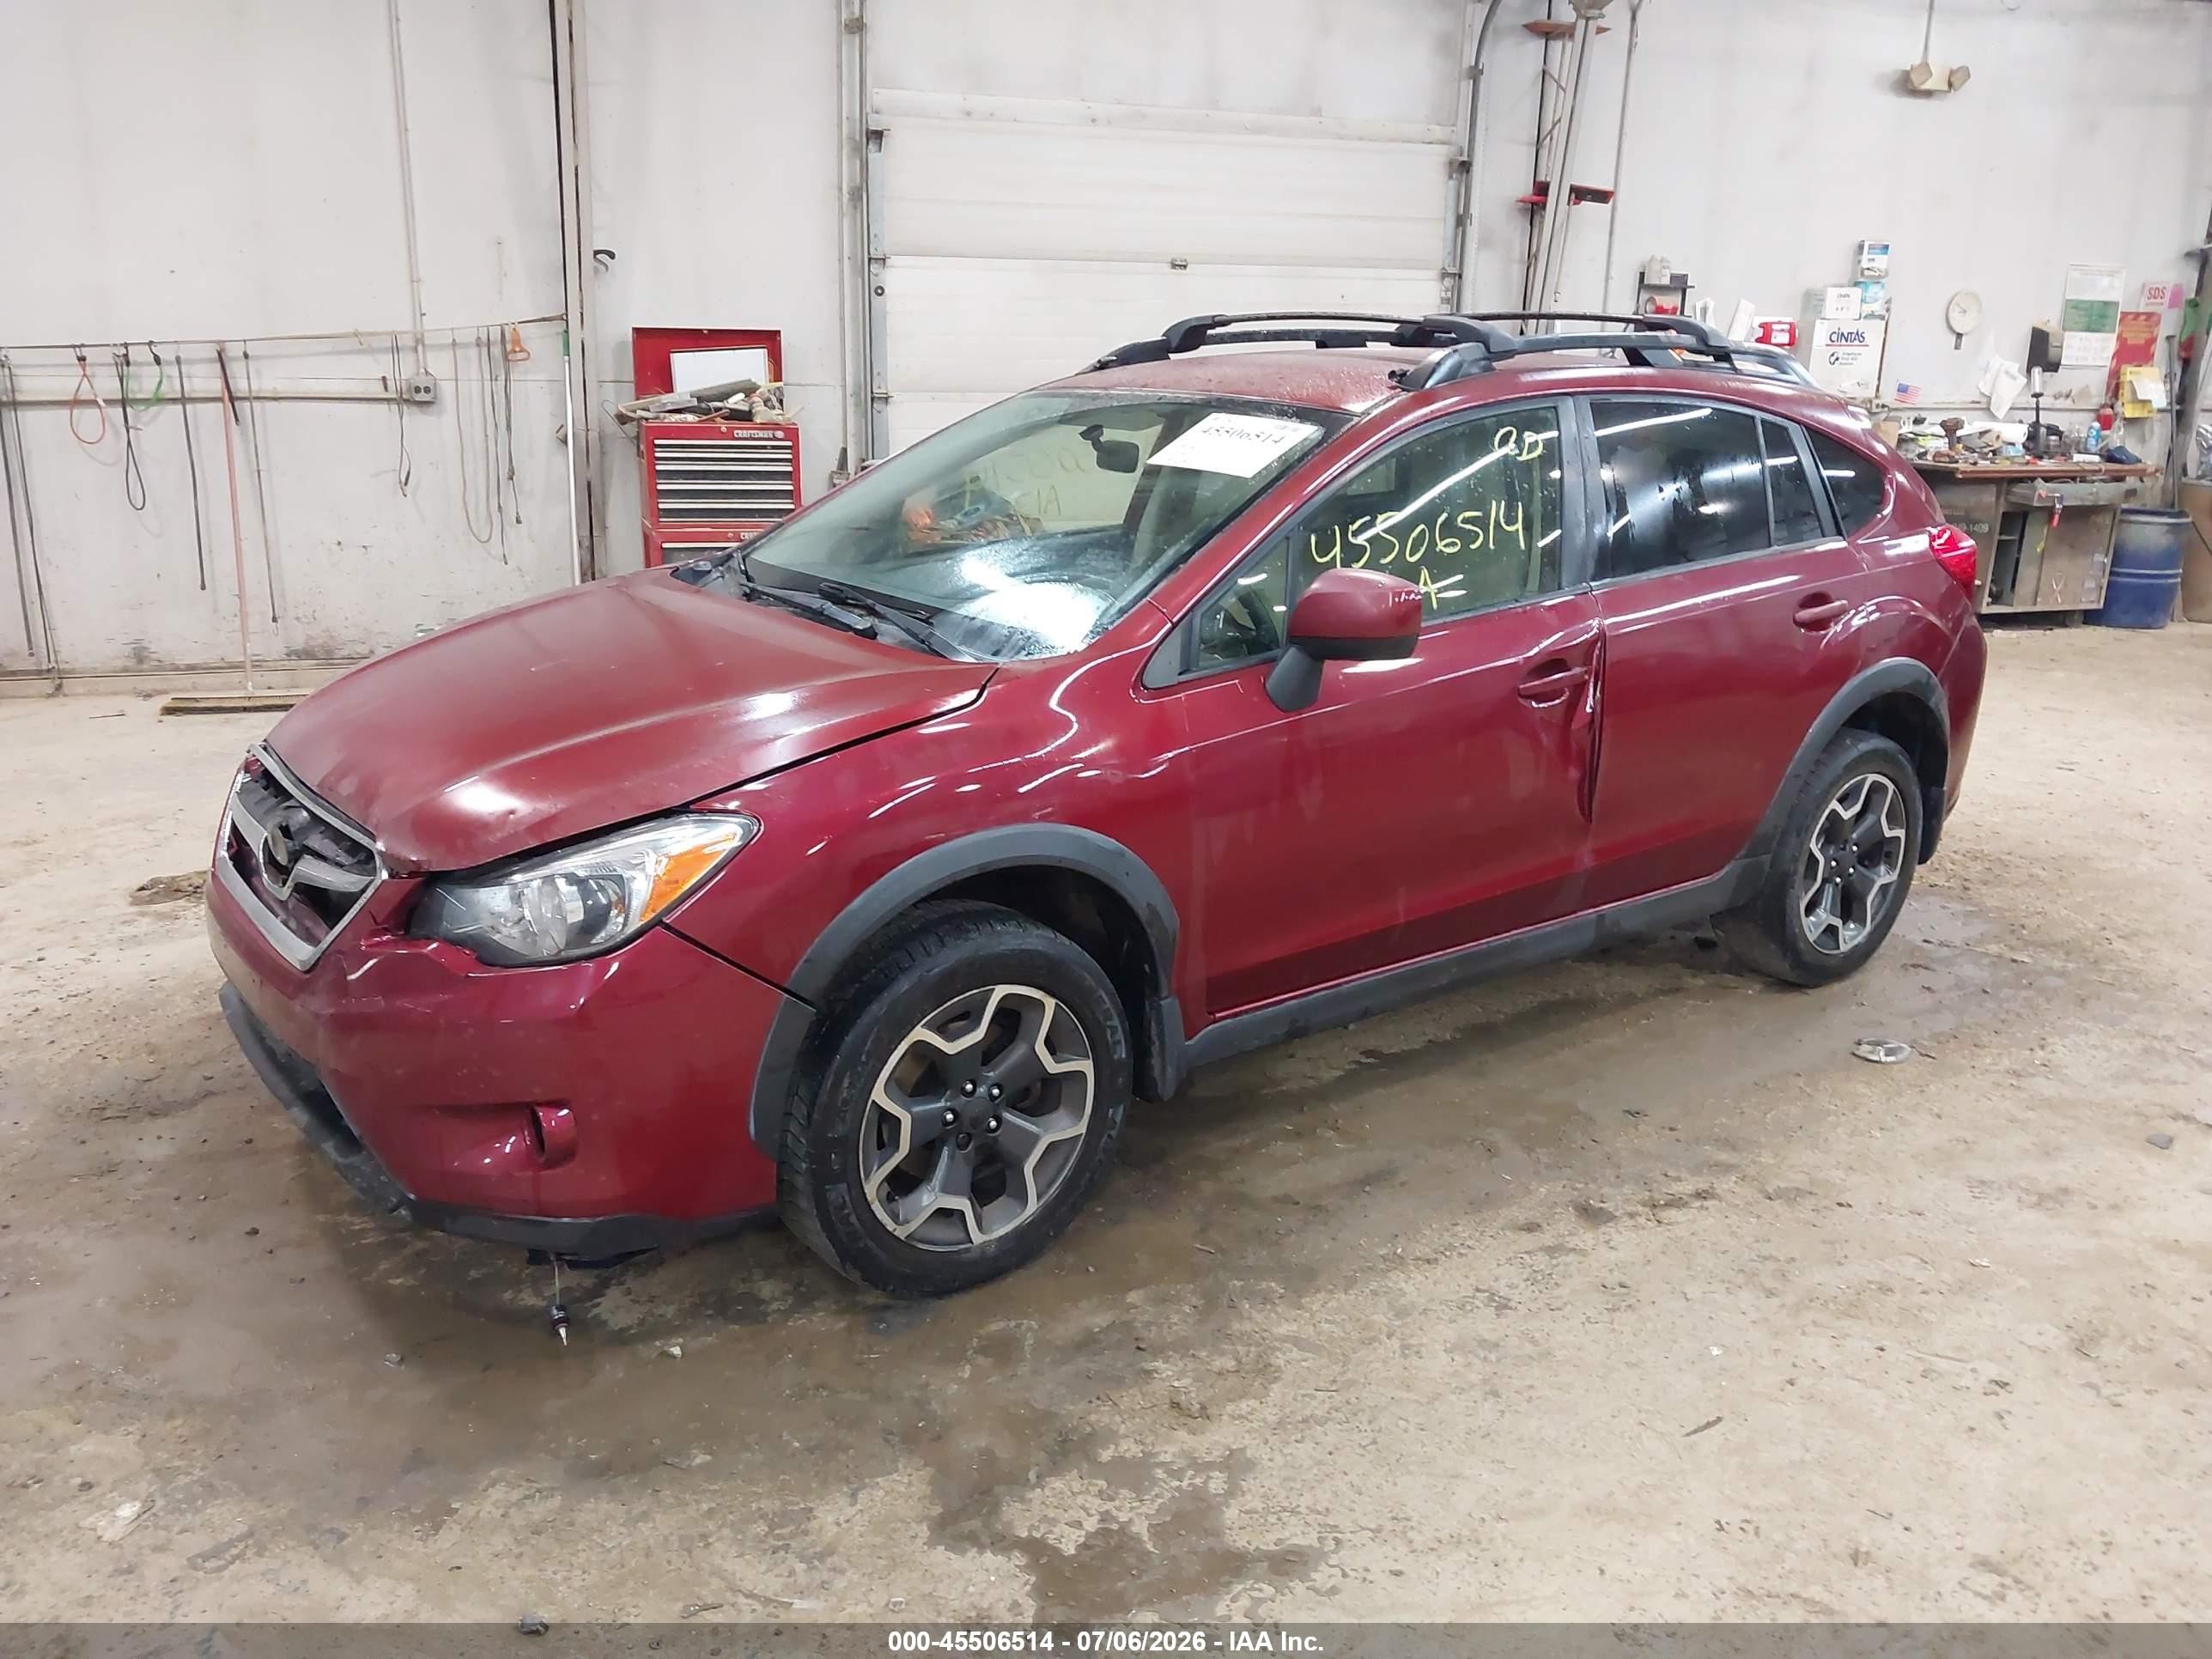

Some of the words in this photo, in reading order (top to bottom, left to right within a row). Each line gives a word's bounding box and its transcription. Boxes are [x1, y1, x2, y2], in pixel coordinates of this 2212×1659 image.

[2147, 287, 2166, 301] SDS
[1829, 327, 1865, 343] CINTAS
[1310, 500, 1526, 569] 45506514
